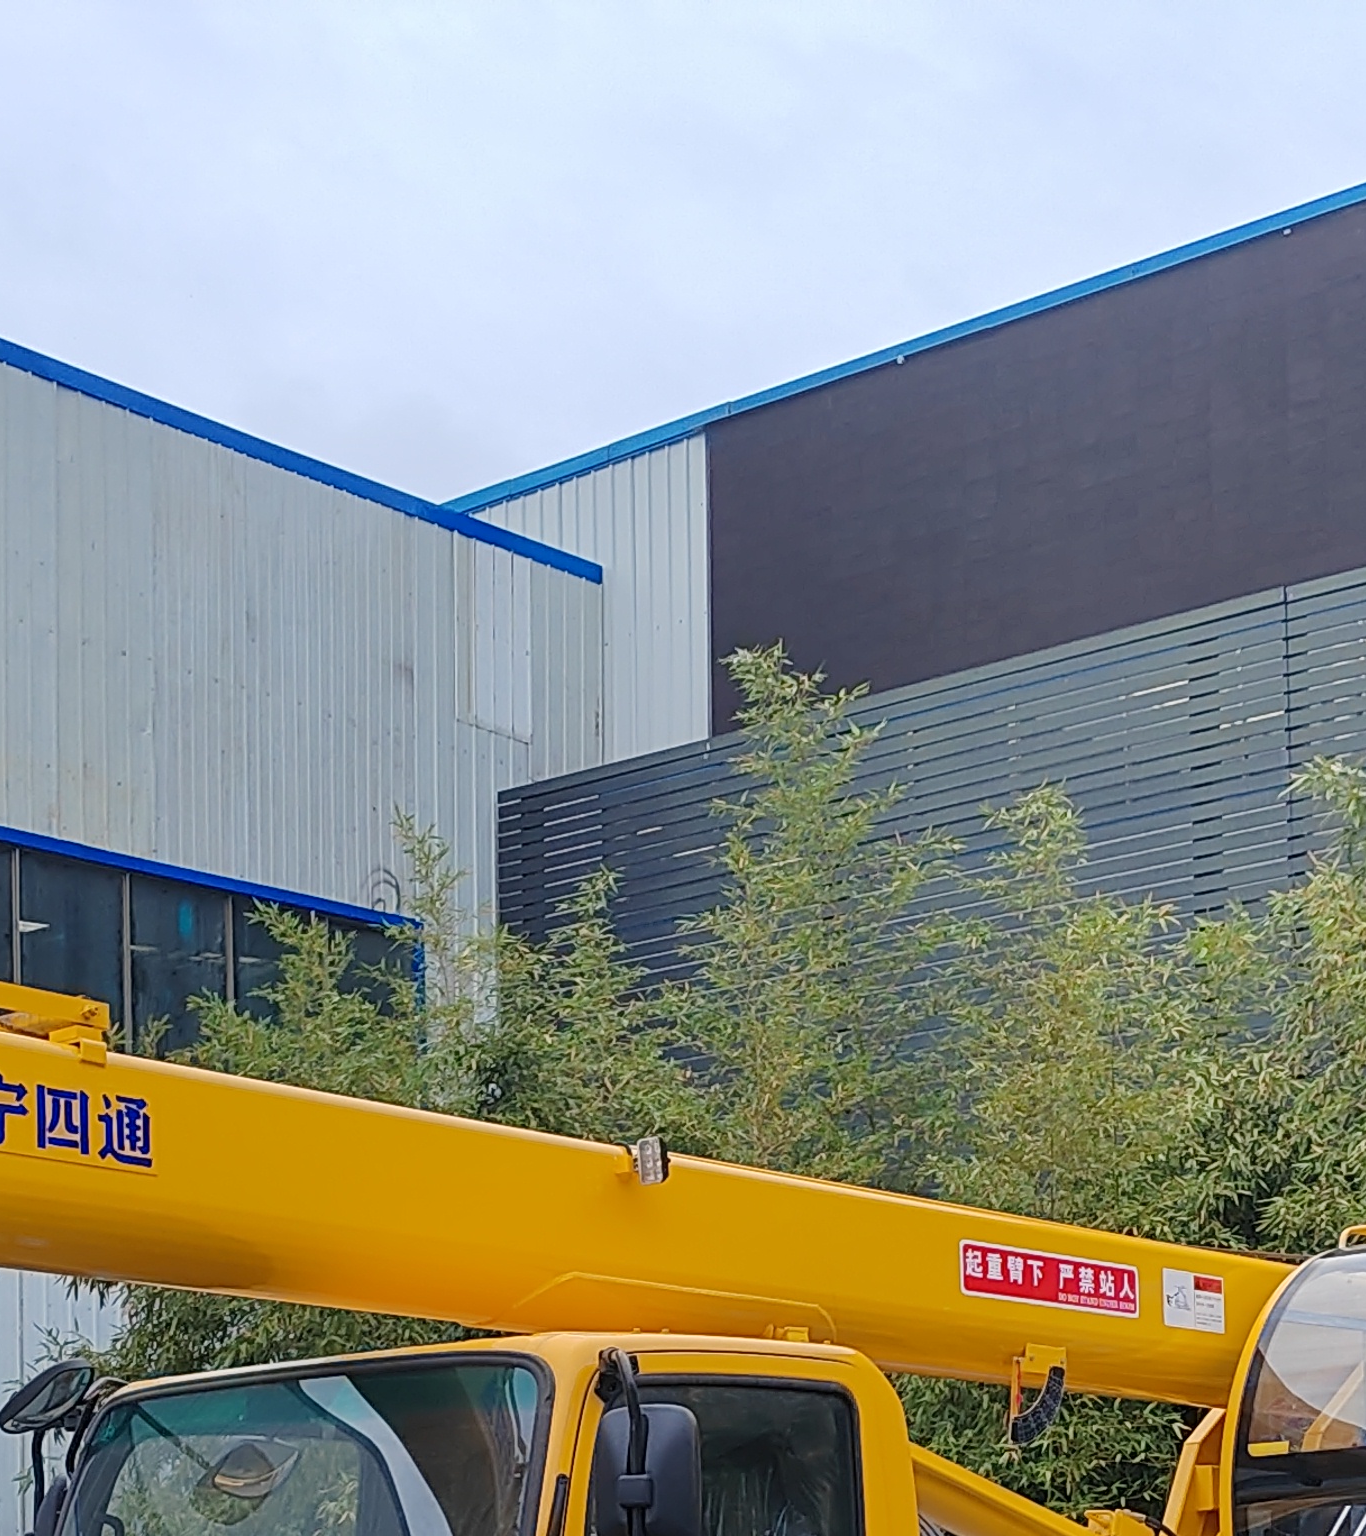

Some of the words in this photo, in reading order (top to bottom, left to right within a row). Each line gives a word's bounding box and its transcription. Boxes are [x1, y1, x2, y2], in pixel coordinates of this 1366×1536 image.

[965, 1248, 1044, 1286] 起重臂下
[1058, 1263, 1135, 1299] 严禁站人
